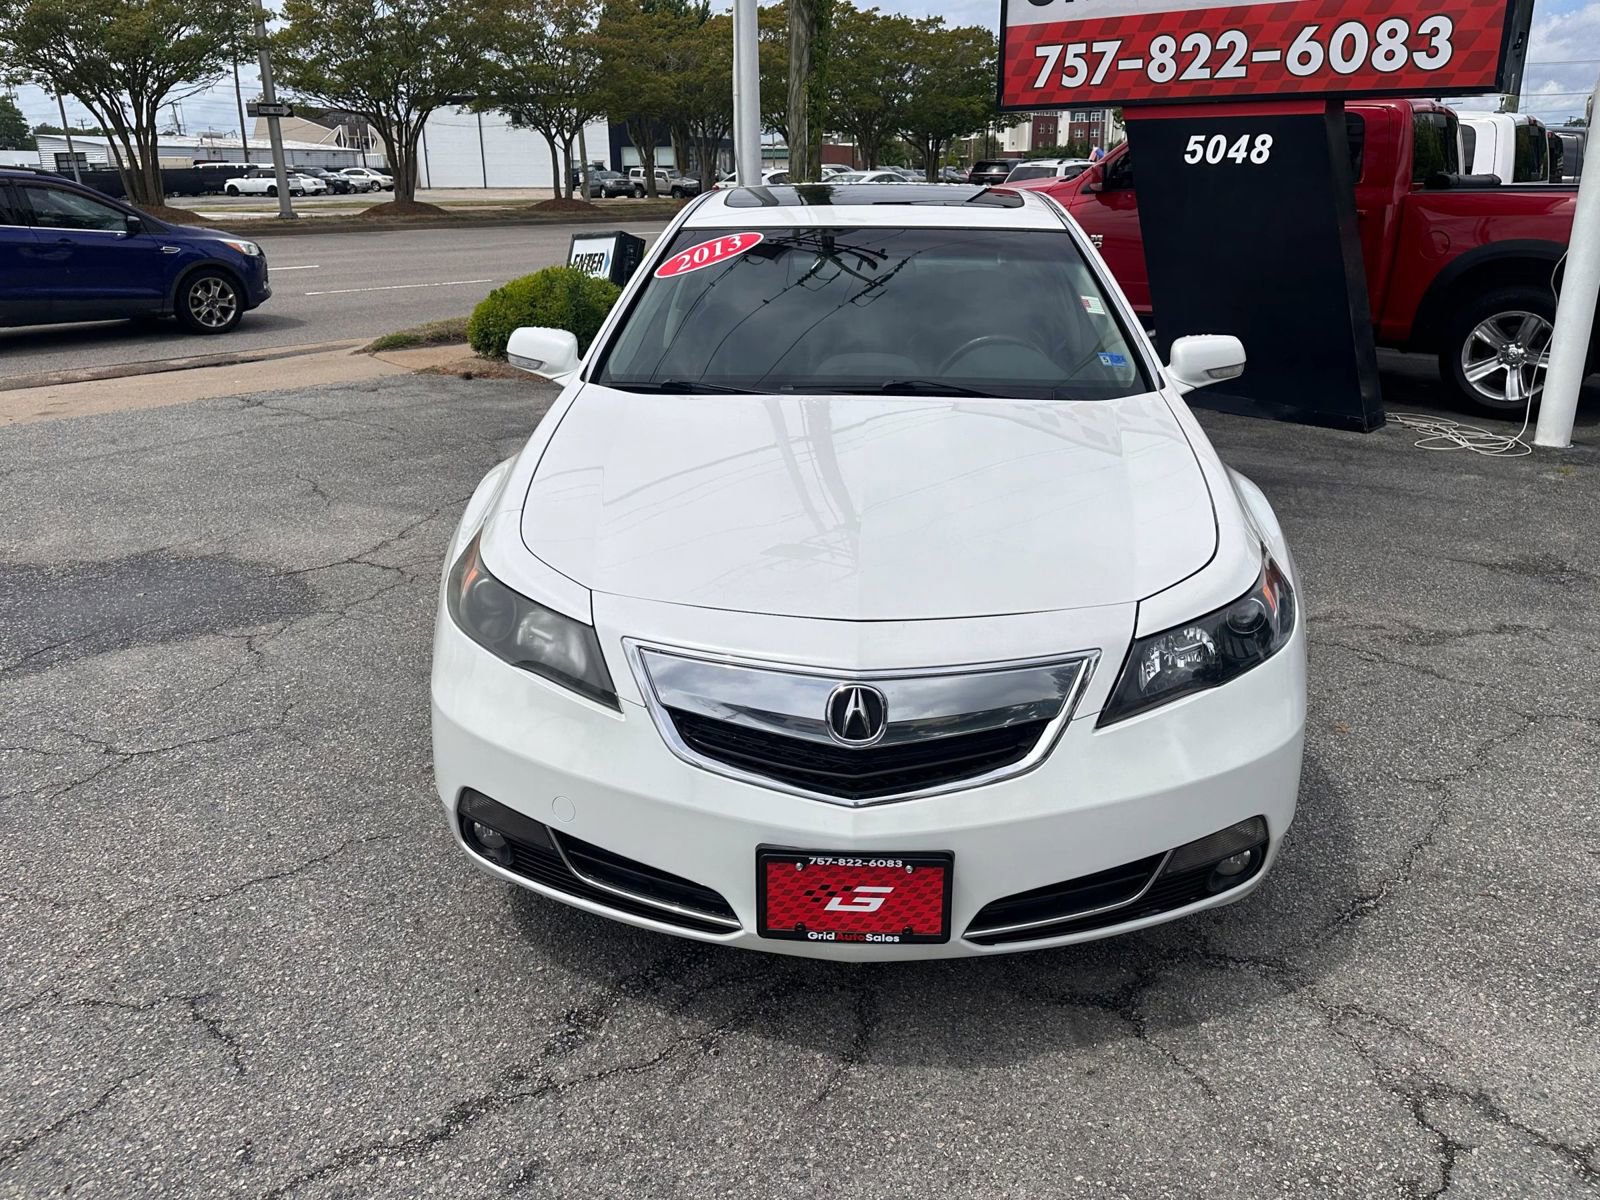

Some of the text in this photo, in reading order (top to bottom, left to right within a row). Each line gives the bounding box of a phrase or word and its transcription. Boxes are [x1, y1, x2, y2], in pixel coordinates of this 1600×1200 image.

[1033, 15, 1453, 88] 757-822-6083
[1184, 133, 1273, 164] 5048
[573, 252, 605, 273] ENTER
[676, 236, 742, 272] 2013
[808, 857, 903, 868] 757-822-6083
